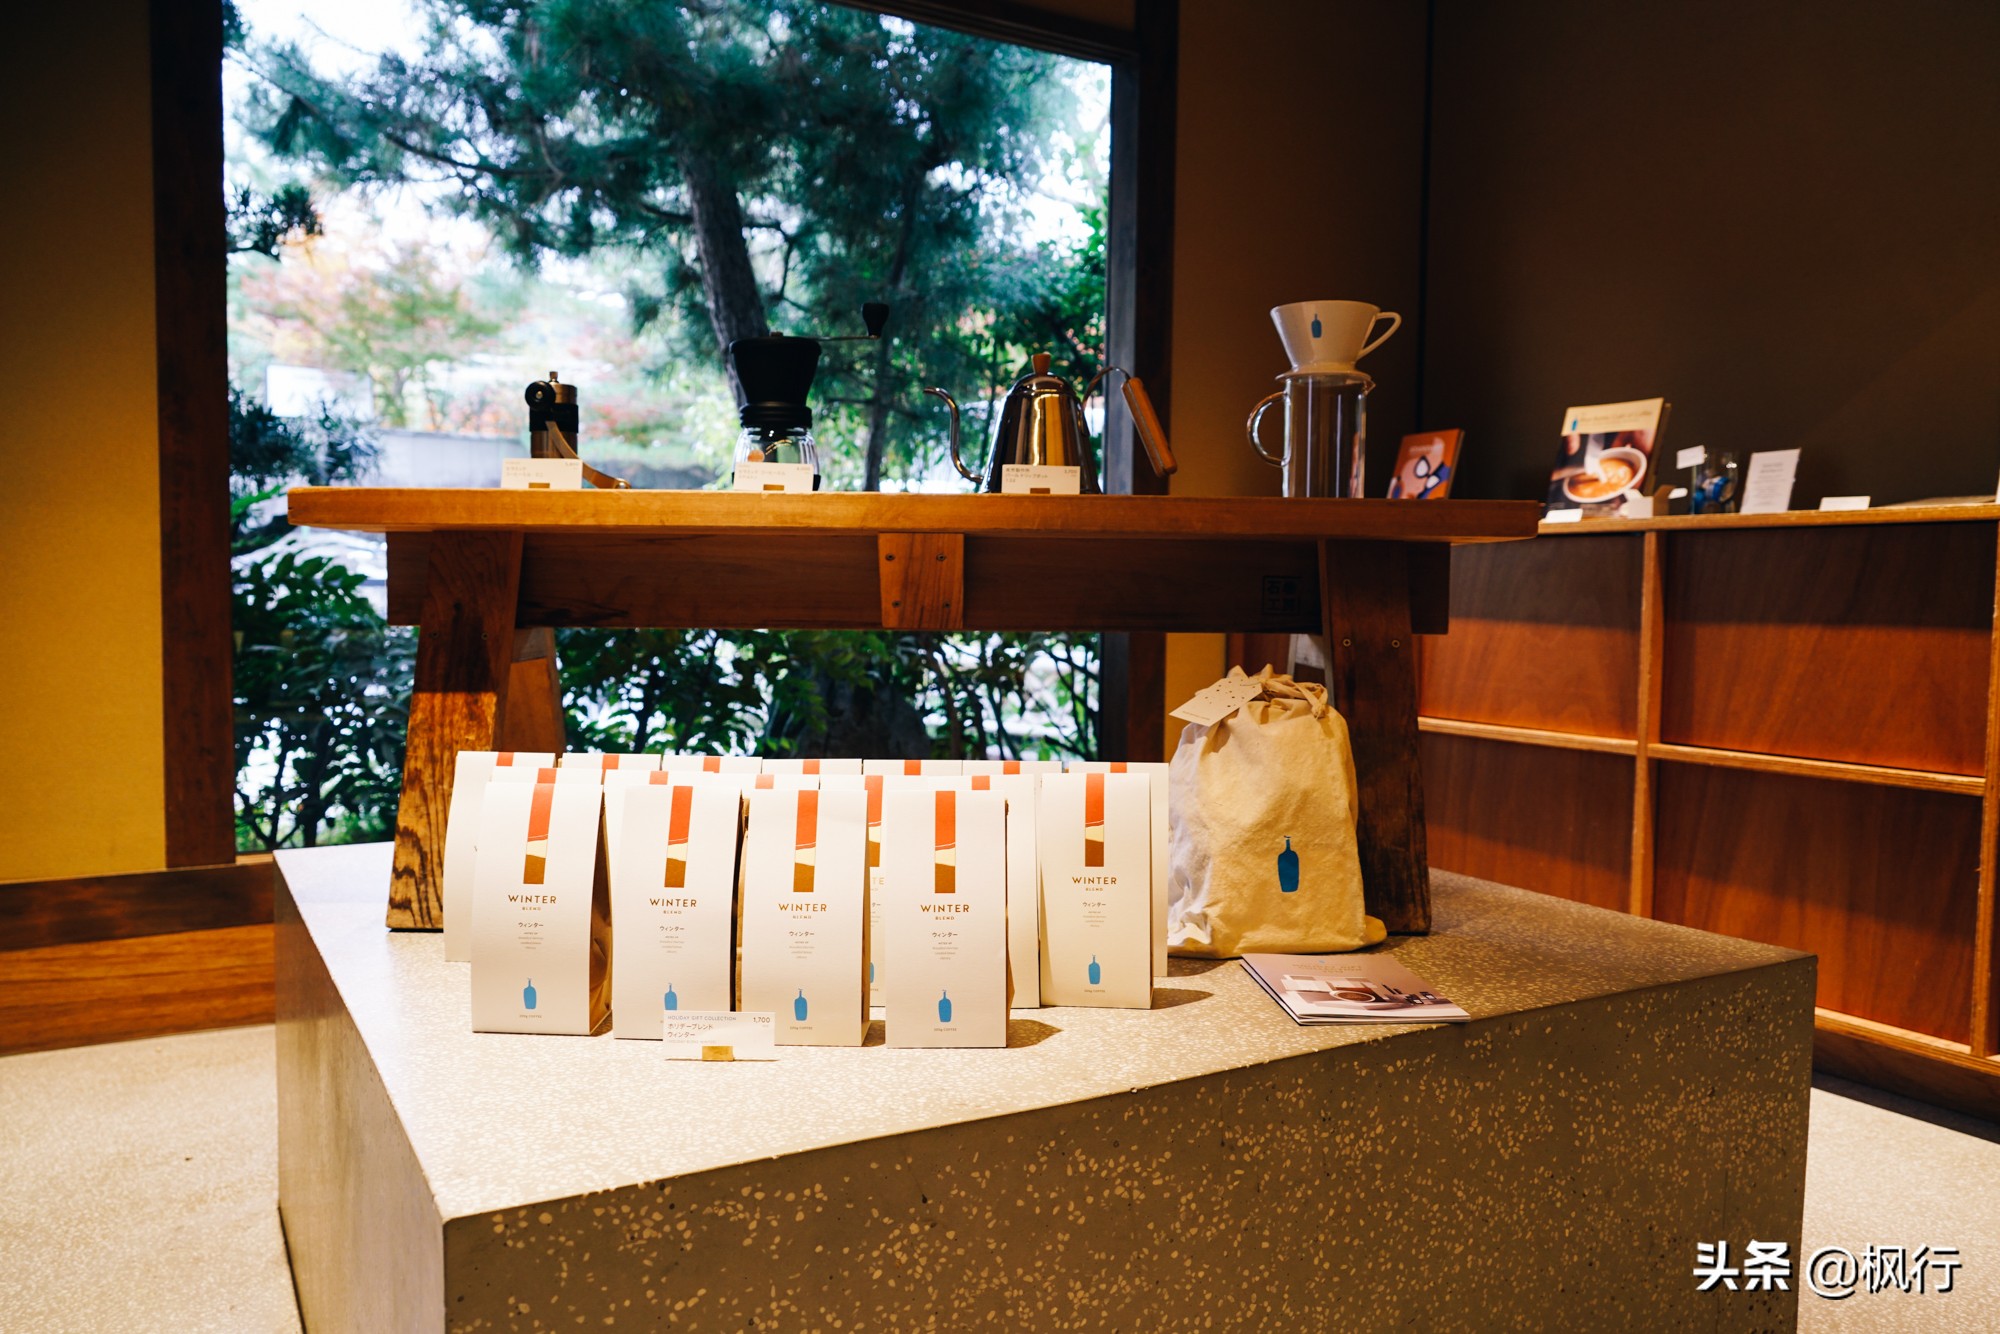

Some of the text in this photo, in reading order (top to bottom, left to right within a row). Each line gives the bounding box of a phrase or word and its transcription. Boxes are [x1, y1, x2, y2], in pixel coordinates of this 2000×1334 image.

[1072, 876, 1117, 885] WINTER
[508, 894, 557, 904] WINTER
[649, 898, 697, 907] WINTER
[778, 903, 827, 912] WINTER
[920, 904, 970, 913] WINTER
